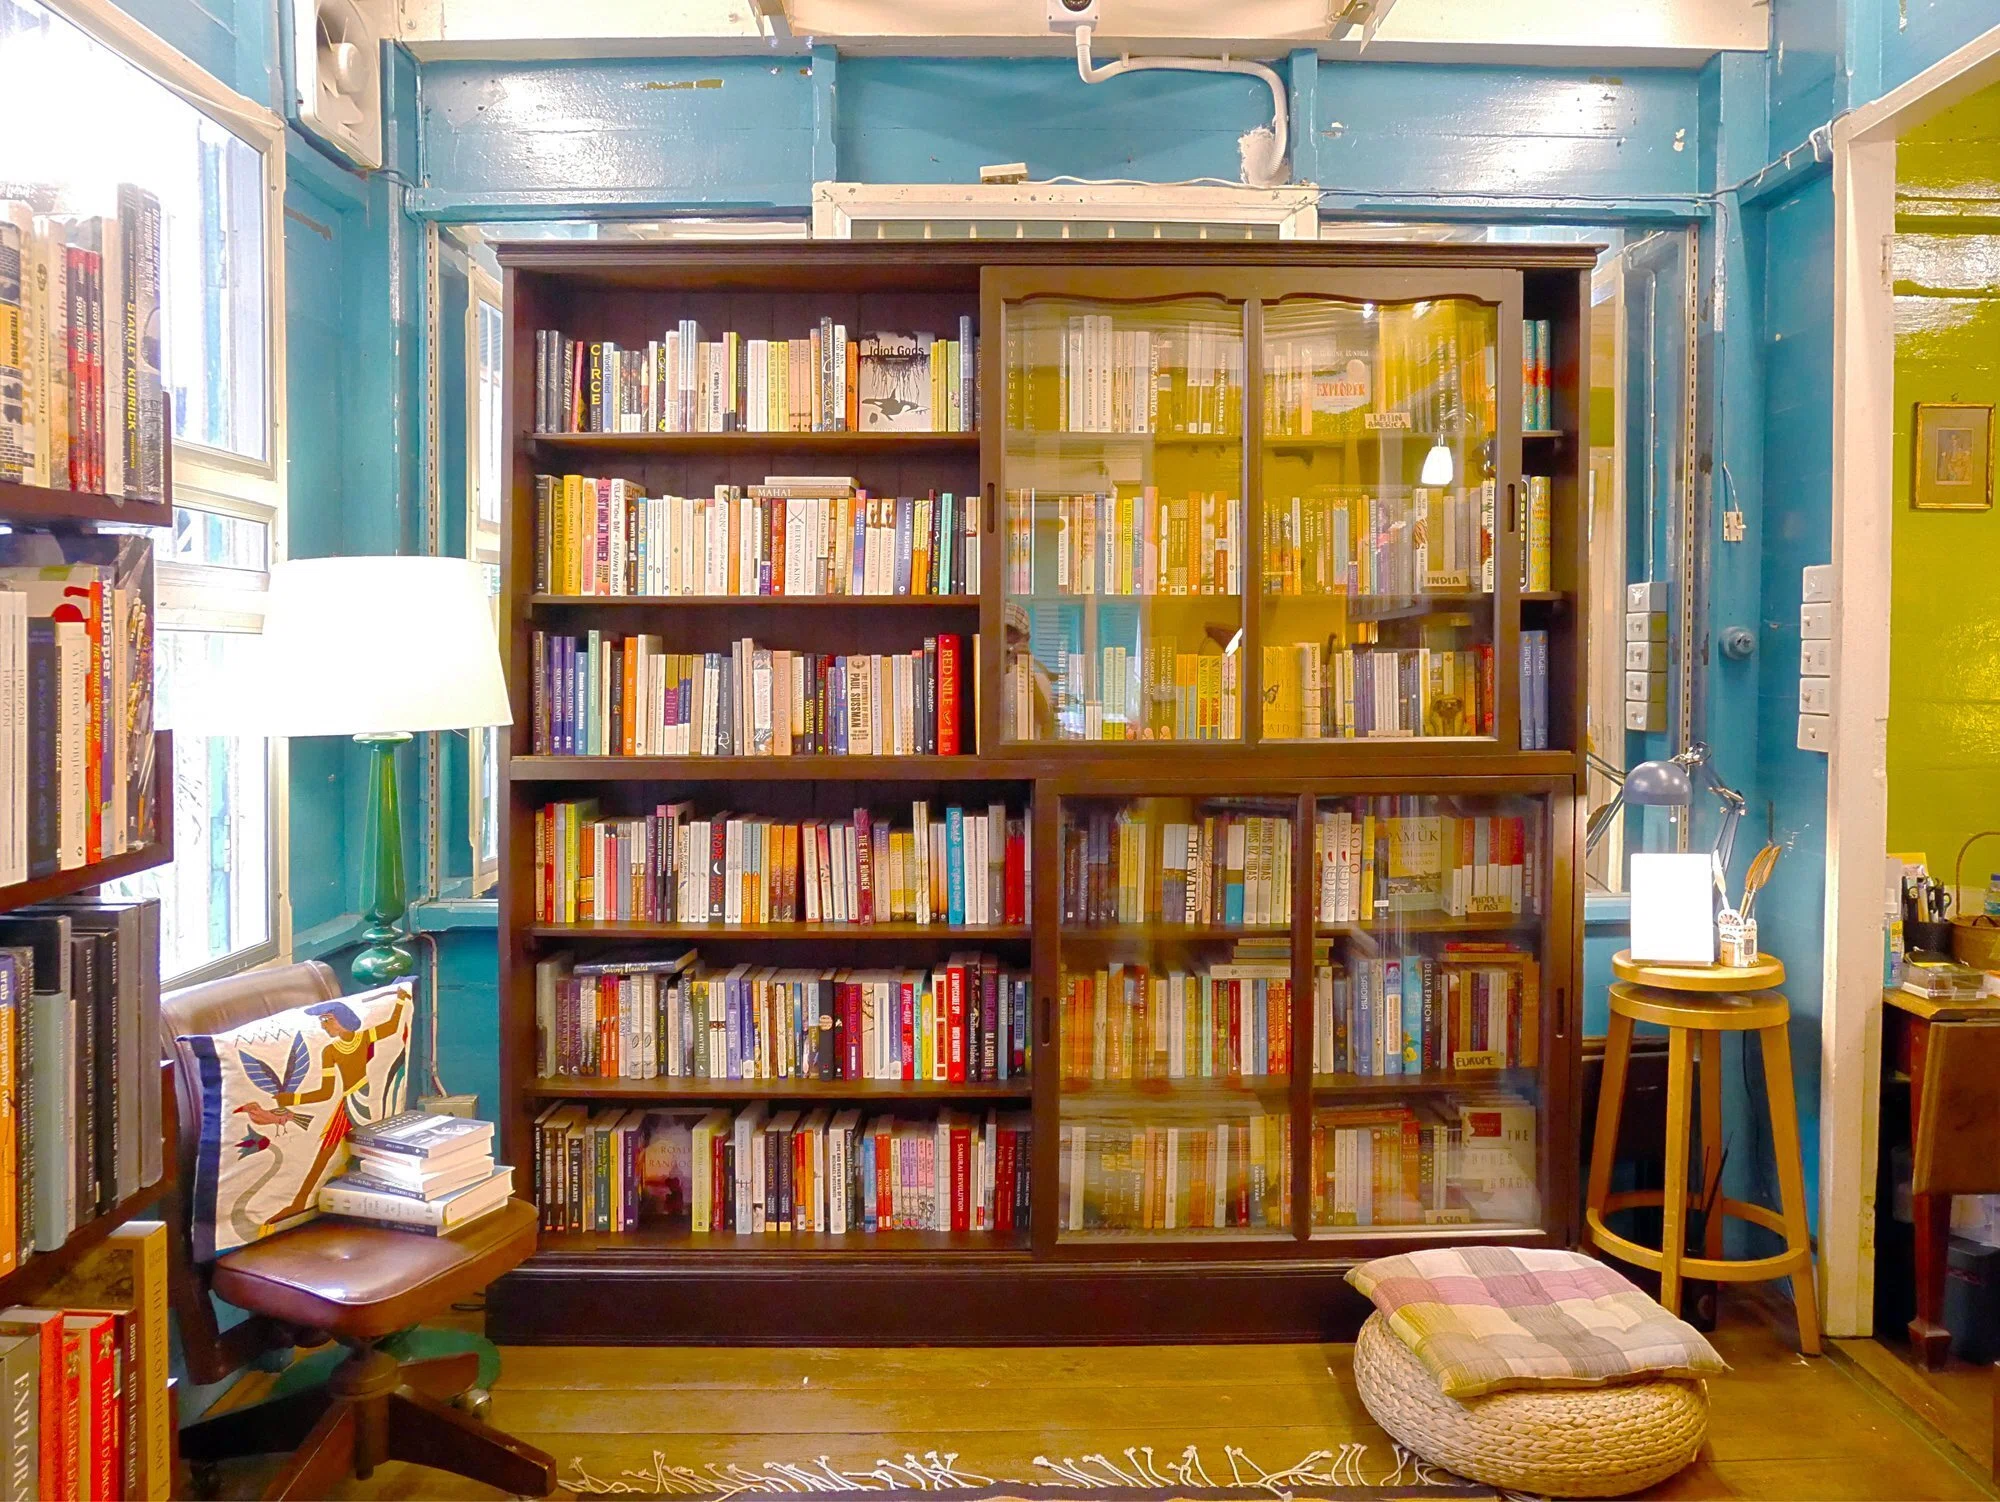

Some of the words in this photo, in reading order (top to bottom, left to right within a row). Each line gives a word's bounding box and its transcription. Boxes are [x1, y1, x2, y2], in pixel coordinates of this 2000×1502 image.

[126, 302, 136, 364] STANLEY
[870, 346, 894, 356] Idiot
[897, 345, 924, 356] Gods
[591, 344, 602, 405] CIRCE
[1007, 340, 1016, 410] WITCHES
[126, 368, 136, 430] KUBRICK
[598, 488, 609, 507] LAST
[757, 488, 792, 497] MAHAL
[598, 510, 609, 524] MAN
[598, 524, 609, 533] IN
[1107, 534, 1113, 542] on
[598, 536, 609, 561] TOWER
[1428, 576, 1460, 585] INDIA
[101, 578, 112, 678] Wallpaper
[72, 648, 80, 656] A
[93, 642, 101, 660] THE
[942, 650, 952, 675] RED
[72, 659, 80, 716] HISTORY
[93, 662, 101, 694] WORLD
[850, 673, 860, 690] PAUL
[942, 677, 952, 705] NILE
[93, 697, 101, 720] GOES
[850, 693, 860, 728] SUSSMAN
[72, 724, 80, 736] IN
[93, 722, 101, 742] POP
[72, 740, 80, 796] OBJECTS
[858, 835, 867, 847] THE
[1247, 821, 1258, 843] AMOS
[1261, 821, 1272, 843] AMOS
[1328, 820, 1336, 848] HANIF
[1386, 830, 1439, 842] PAMUK
[712, 834, 723, 860] ROPE
[860, 848, 868, 863] KITE
[1186, 840, 1197, 861] THE
[1247, 846, 1258, 856] OZ
[1261, 846, 1272, 856] OZ
[1350, 827, 1360, 874] SOLO
[860, 864, 870, 890] RUNNER
[1247, 857, 1258, 881] JUDAS
[1261, 858, 1272, 881] JUDAS
[1186, 869, 1197, 912] WATCH
[602, 965, 623, 974] Saving
[904, 989, 912, 1004] APPLE
[952, 980, 960, 1005] IMPECCABLE
[904, 1010, 912, 1024] RAIN
[952, 1006, 960, 1014] SPY
[952, 1027, 960, 1039] OWEN
[0, 1004, 9, 1086] photography
[952, 1040, 960, 1062] MATTHEWS
[1456, 1056, 1494, 1066] EUROPE
[86, 1094, 92, 1104] OF
[1507, 1130, 1529, 1141] THE
[1436, 1215, 1462, 1224] ASIA
[153, 1280, 164, 1310] THE
[153, 1314, 164, 1349] END
[153, 1358, 164, 1378] OF
[153, 1388, 164, 1417] THE
[153, 1424, 164, 1472] GAME
